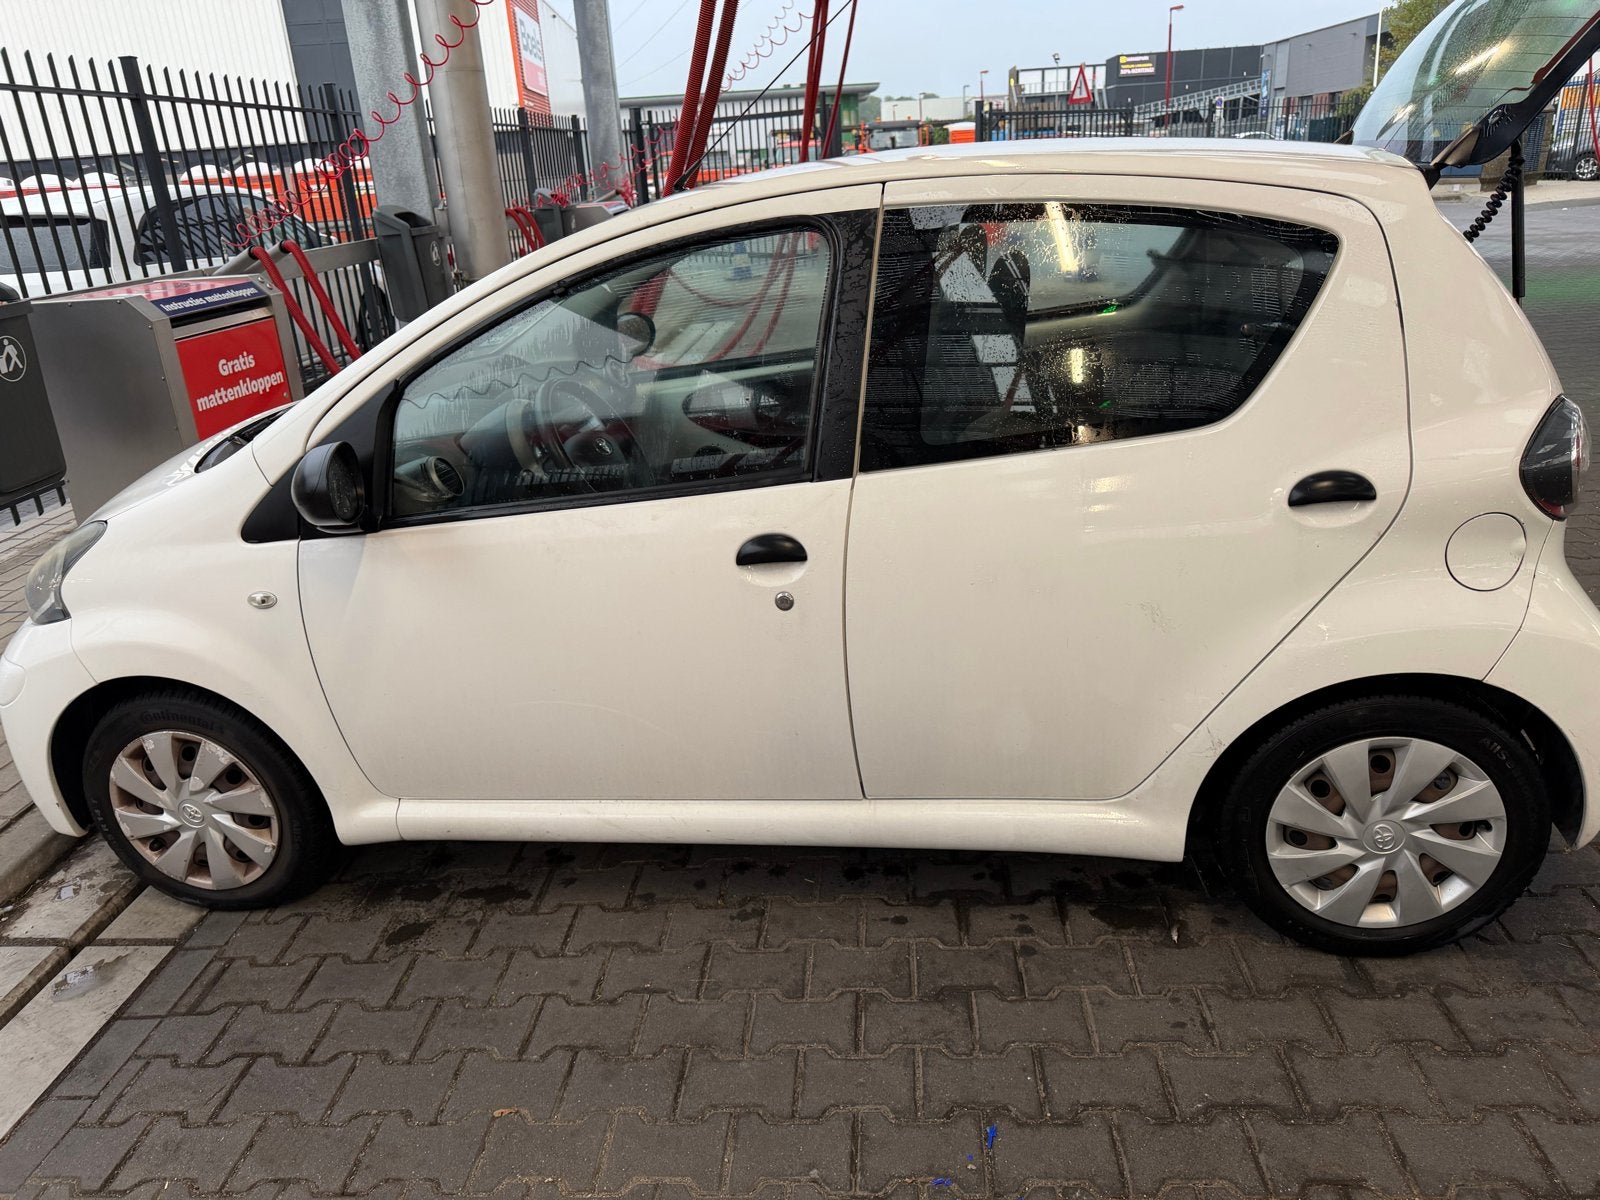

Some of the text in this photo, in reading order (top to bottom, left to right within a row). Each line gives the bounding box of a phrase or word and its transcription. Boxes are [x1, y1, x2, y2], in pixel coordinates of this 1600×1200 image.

[160, 286, 259, 312] Instructies mattenkloppen
[218, 351, 256, 376] Gratis
[196, 371, 284, 412] mattenkloppen
